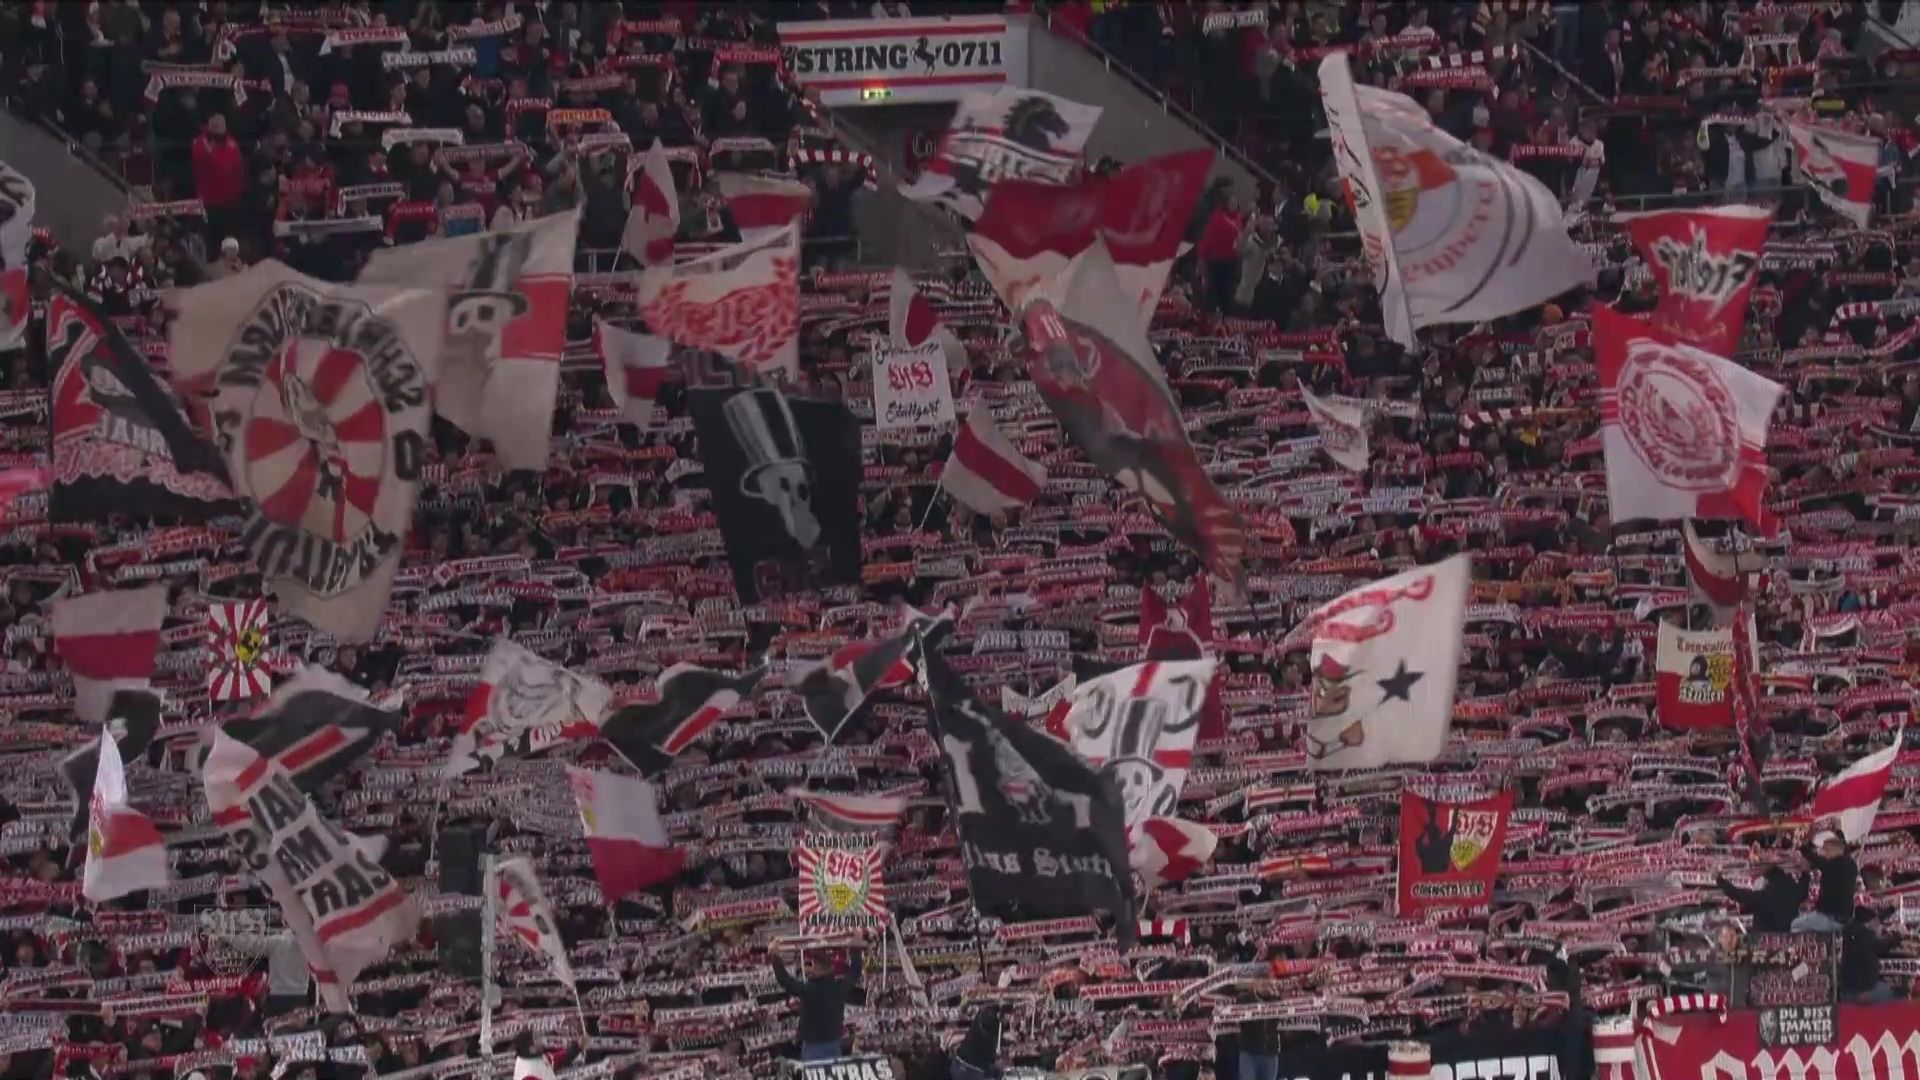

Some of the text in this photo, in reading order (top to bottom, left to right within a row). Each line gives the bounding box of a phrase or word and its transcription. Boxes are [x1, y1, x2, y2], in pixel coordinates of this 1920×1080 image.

[942, 40, 1002, 66] 0711
[1779, 1005, 1832, 1018] DU BIST
[1779, 1018, 1832, 1032] IMMER
